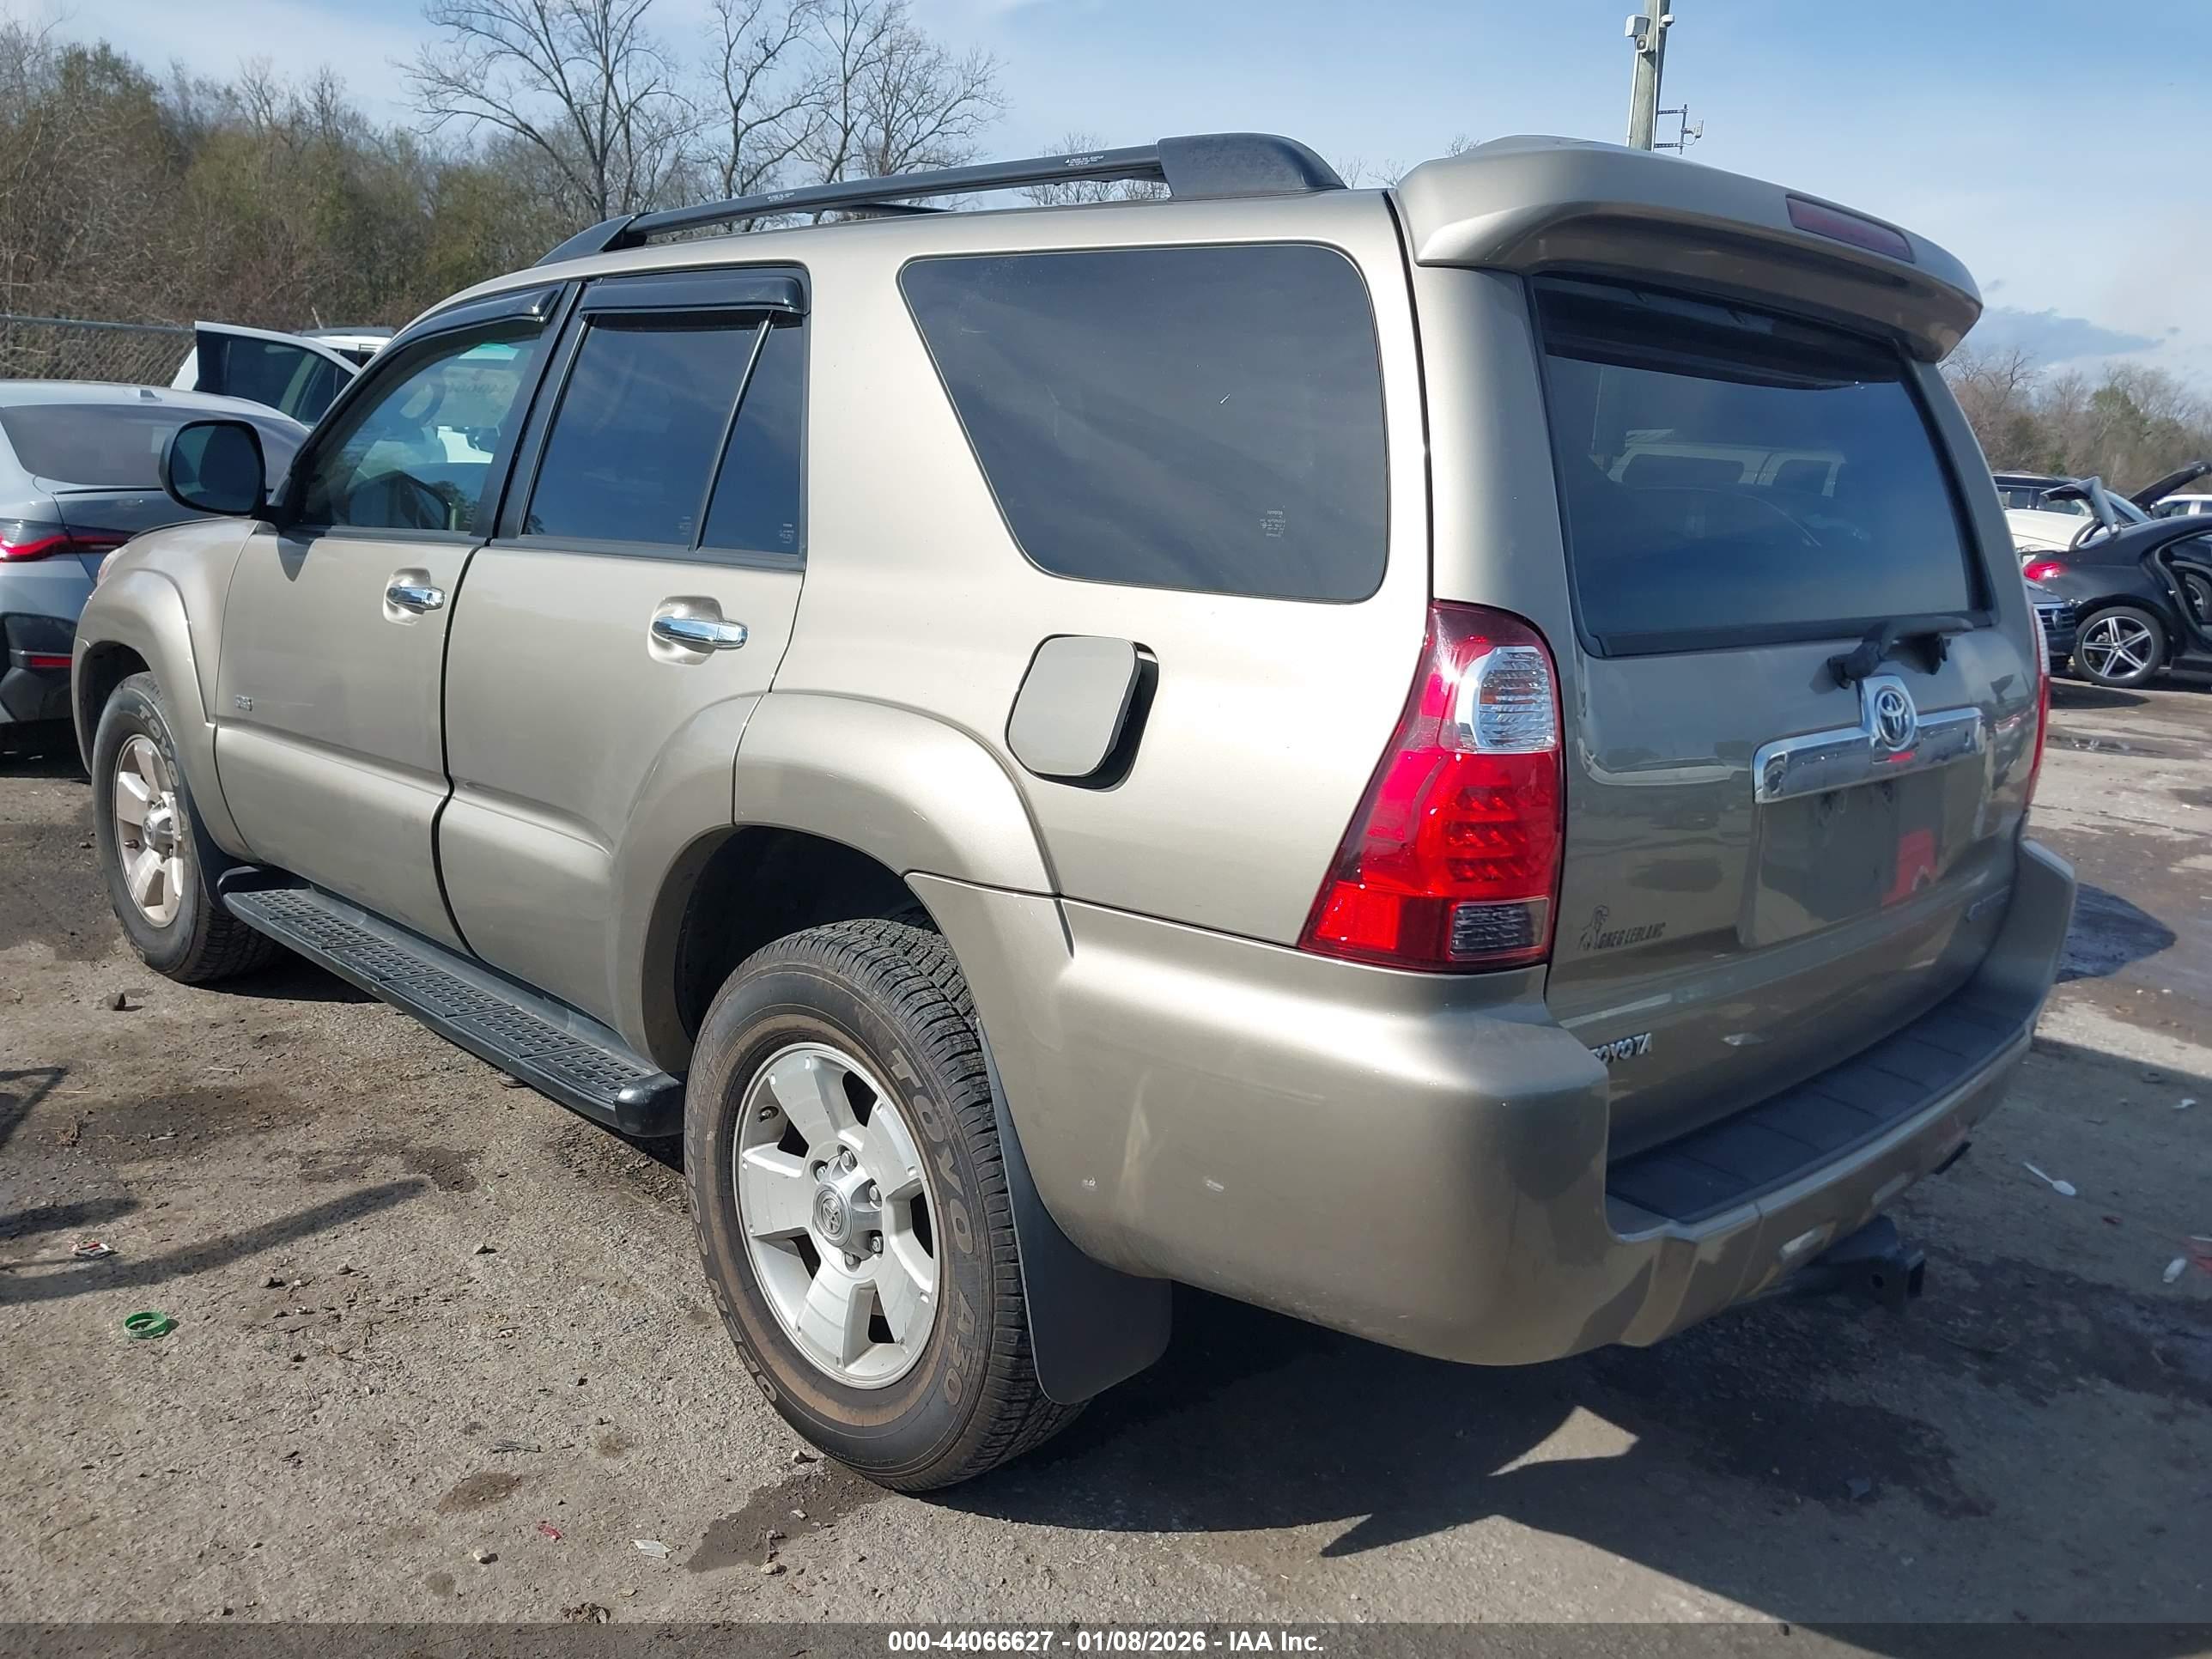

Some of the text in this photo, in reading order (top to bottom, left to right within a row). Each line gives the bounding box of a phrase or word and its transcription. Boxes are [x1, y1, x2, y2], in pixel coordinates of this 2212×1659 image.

[138, 703, 179, 787] TOYO
[887, 1046, 976, 1407] TOYO A30
